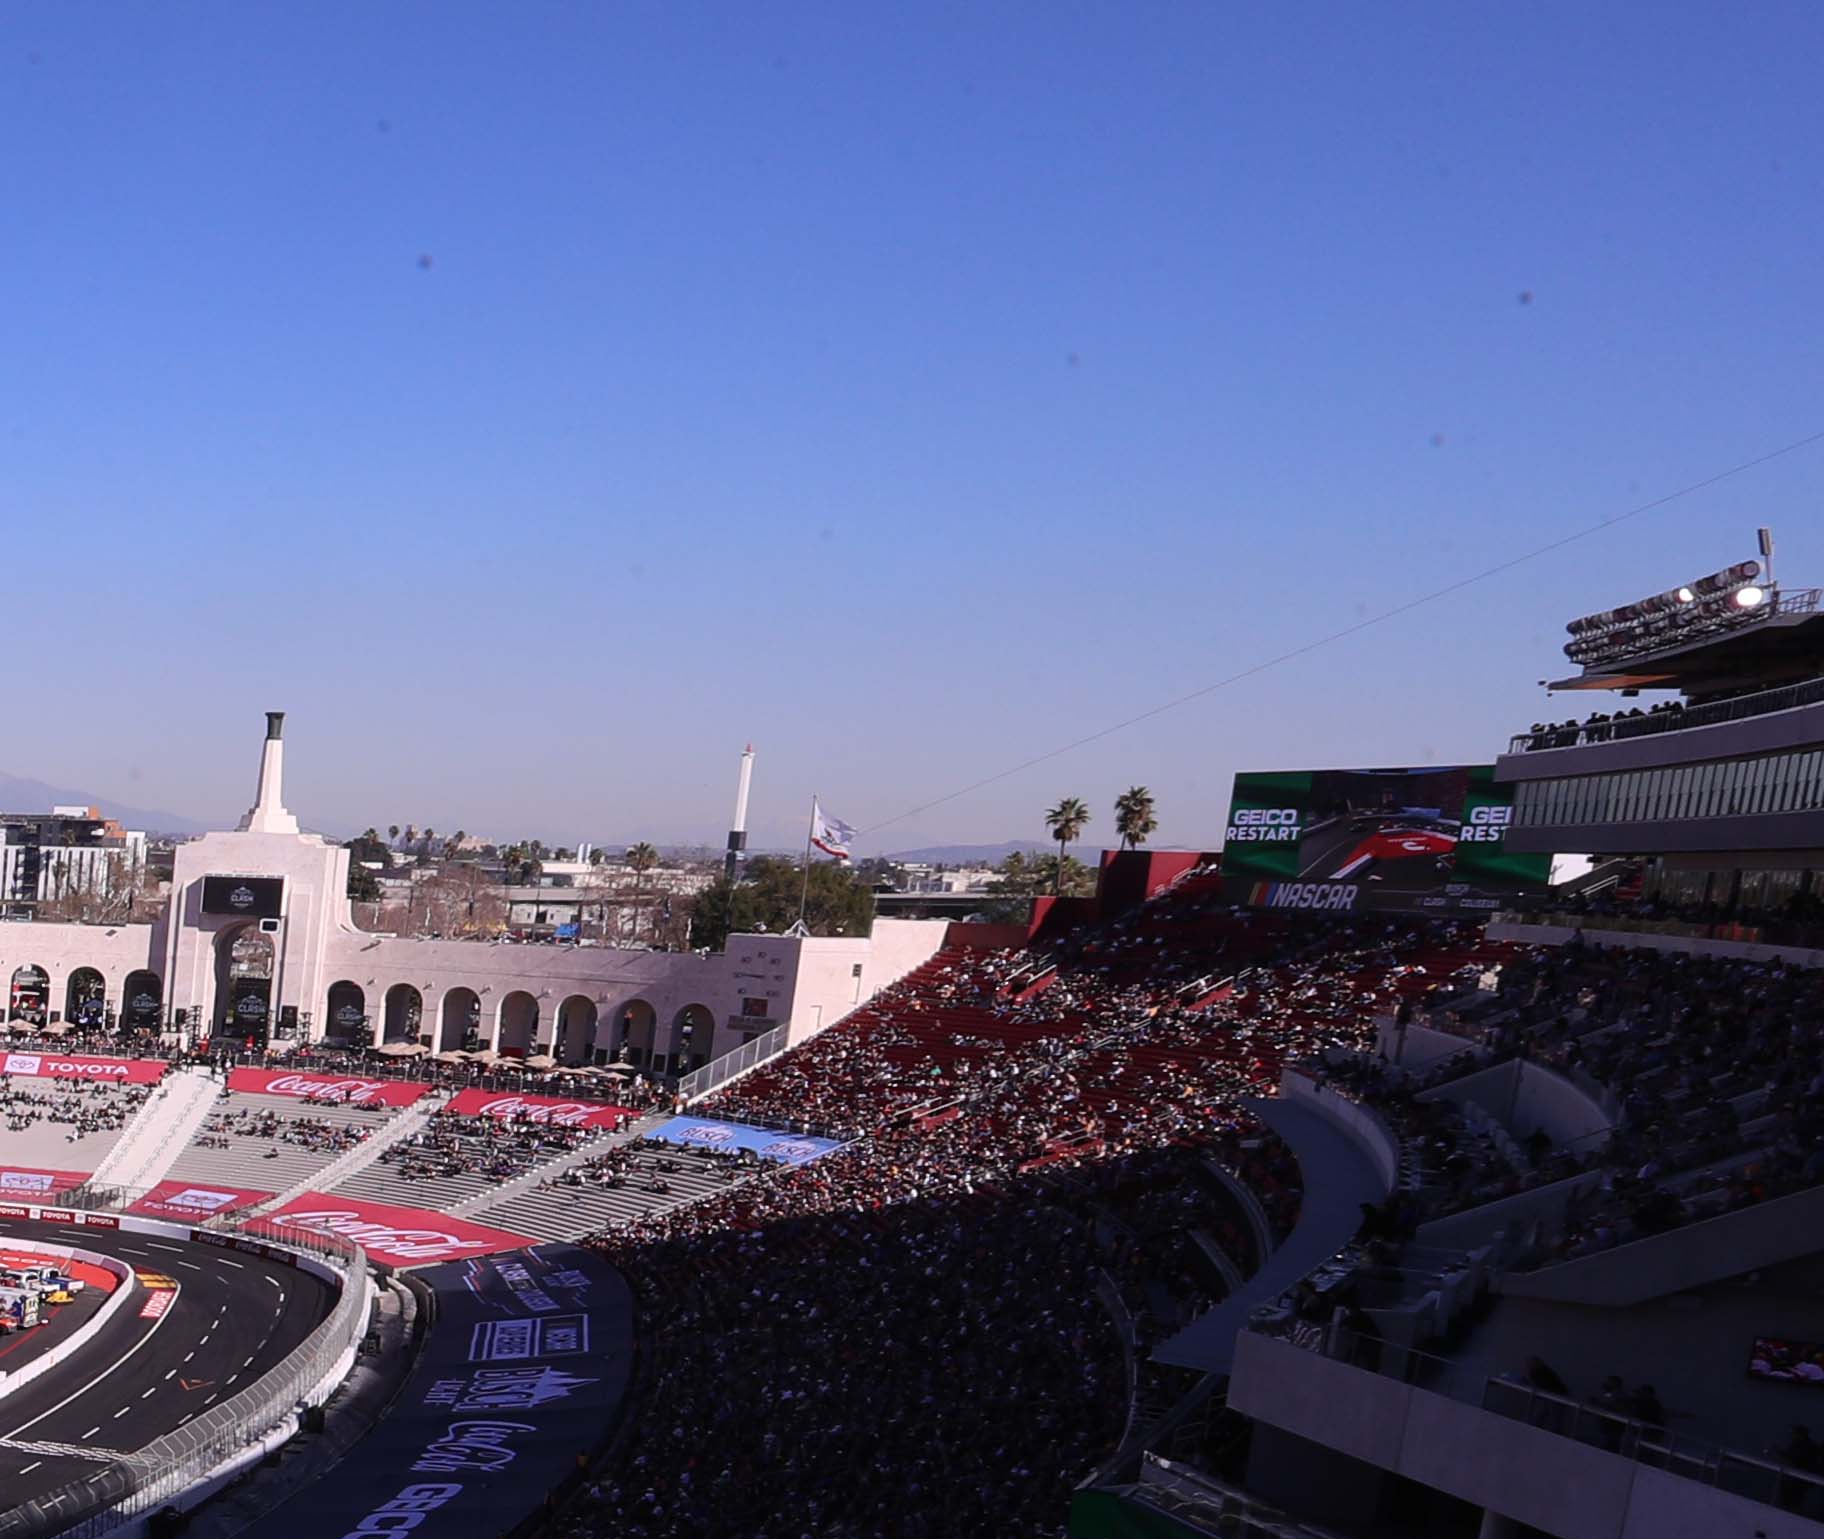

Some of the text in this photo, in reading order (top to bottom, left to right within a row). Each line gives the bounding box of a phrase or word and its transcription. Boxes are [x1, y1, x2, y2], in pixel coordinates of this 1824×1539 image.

[1233, 808, 1297, 825] GEICO
[1225, 826, 1301, 842] RESTART
[1272, 883, 1358, 909] NASCAR
[47, 1061, 129, 1076] TOYOTA
[681, 1125, 733, 1142] BUSCH
[766, 1140, 814, 1158] BUSCH
[41, 1210, 71, 1222] TOYOTA
[87, 1215, 115, 1226] TOYOTA
